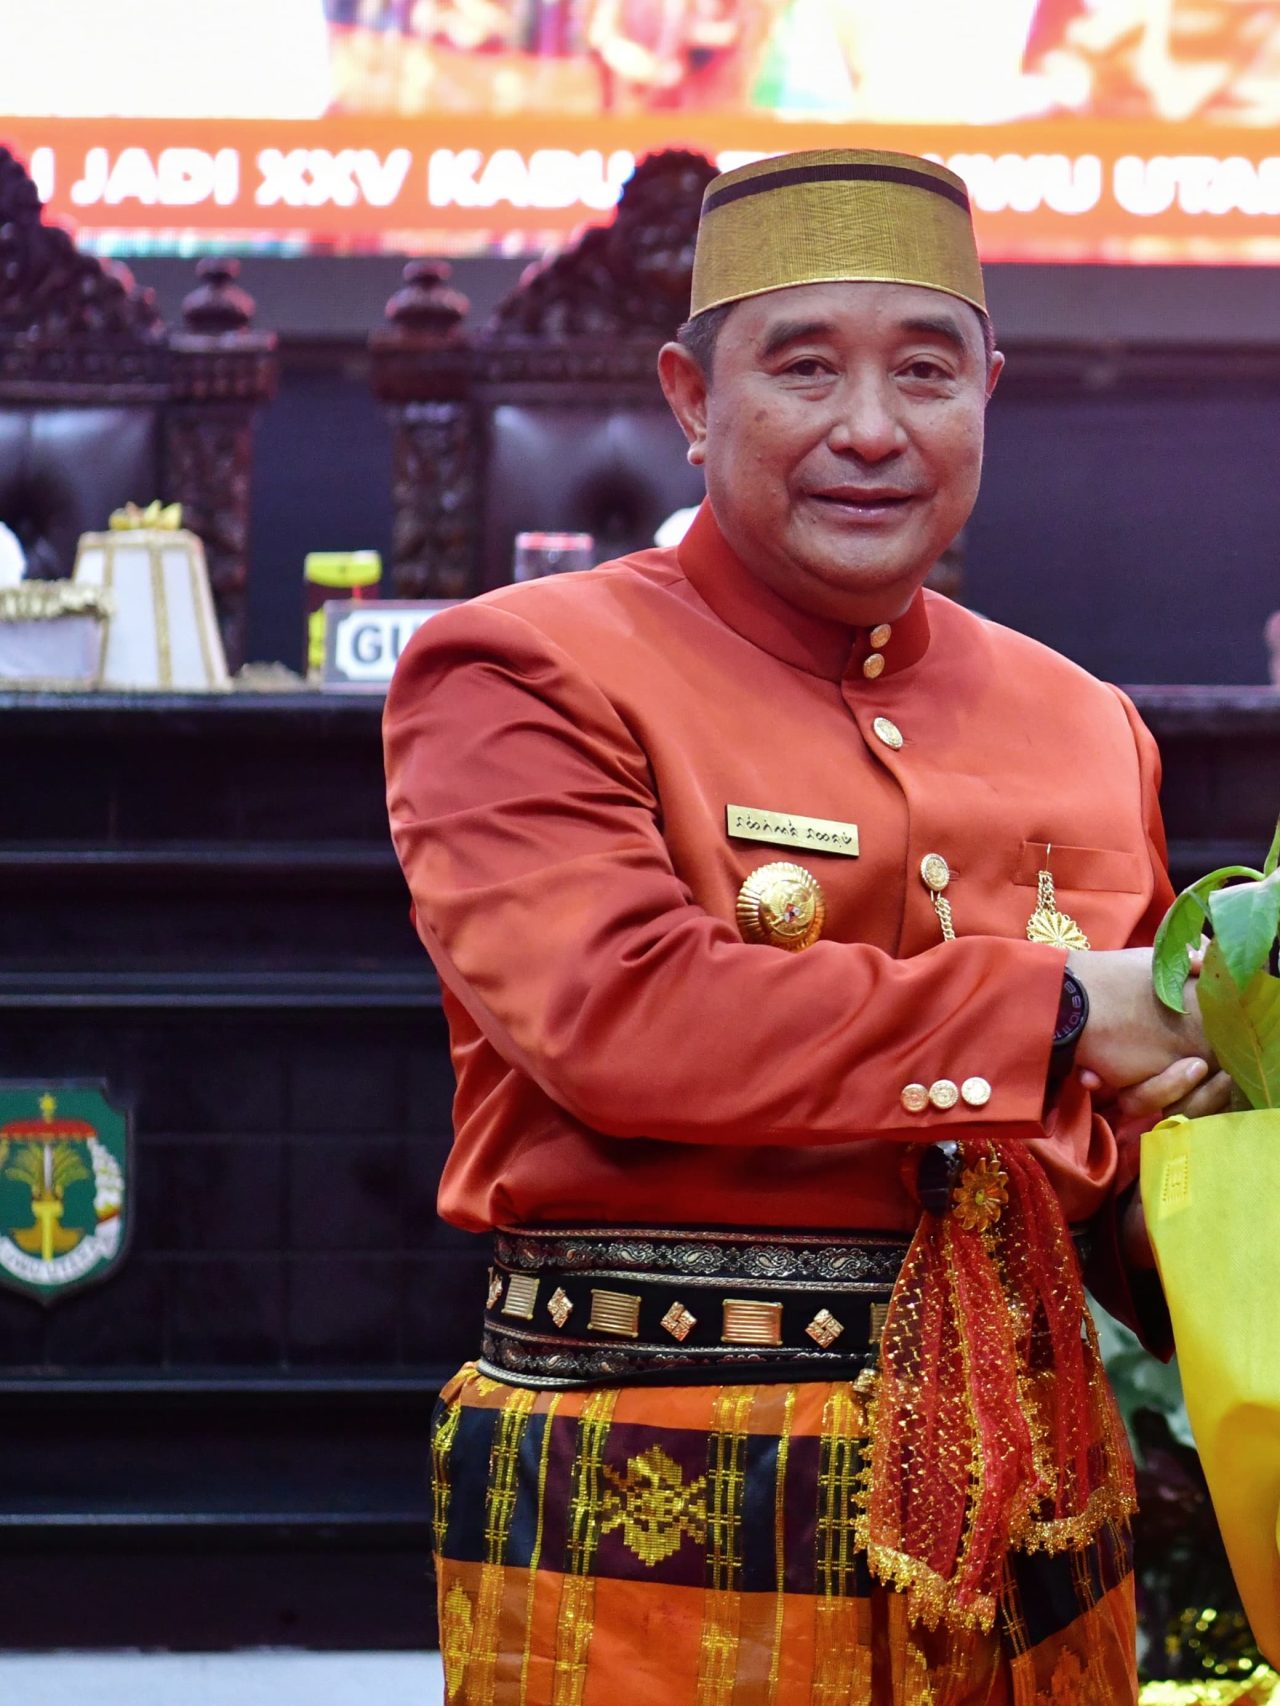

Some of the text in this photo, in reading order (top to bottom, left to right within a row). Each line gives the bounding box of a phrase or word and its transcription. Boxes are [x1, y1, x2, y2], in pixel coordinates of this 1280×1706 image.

[71, 148, 239, 206] JADI
[256, 149, 411, 206] XXV
[429, 149, 636, 209] KABU
